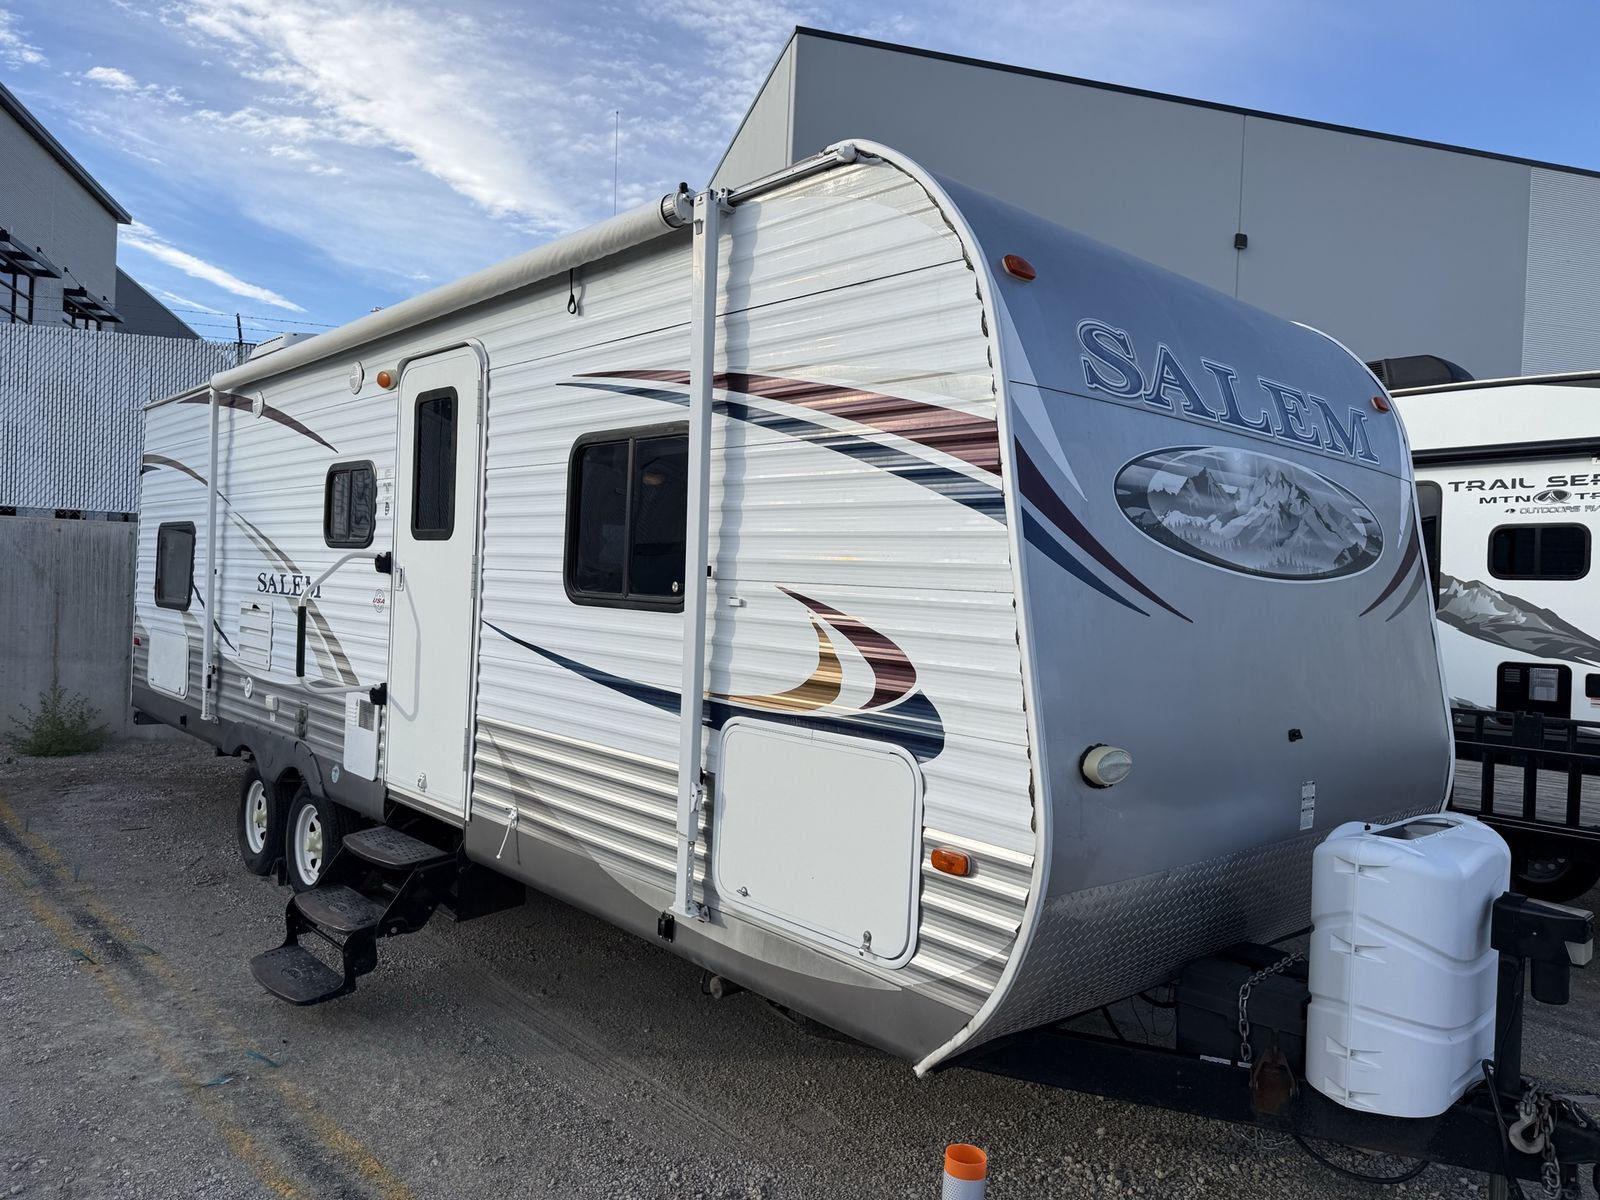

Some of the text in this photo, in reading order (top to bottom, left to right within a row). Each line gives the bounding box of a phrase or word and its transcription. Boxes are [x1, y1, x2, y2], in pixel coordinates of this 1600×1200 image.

[1077, 318, 1380, 465] SALEM
[1448, 478, 1535, 492] TRAIL
[1479, 496, 1531, 504] MTN
[1520, 506, 1580, 514] OUTDOORS
